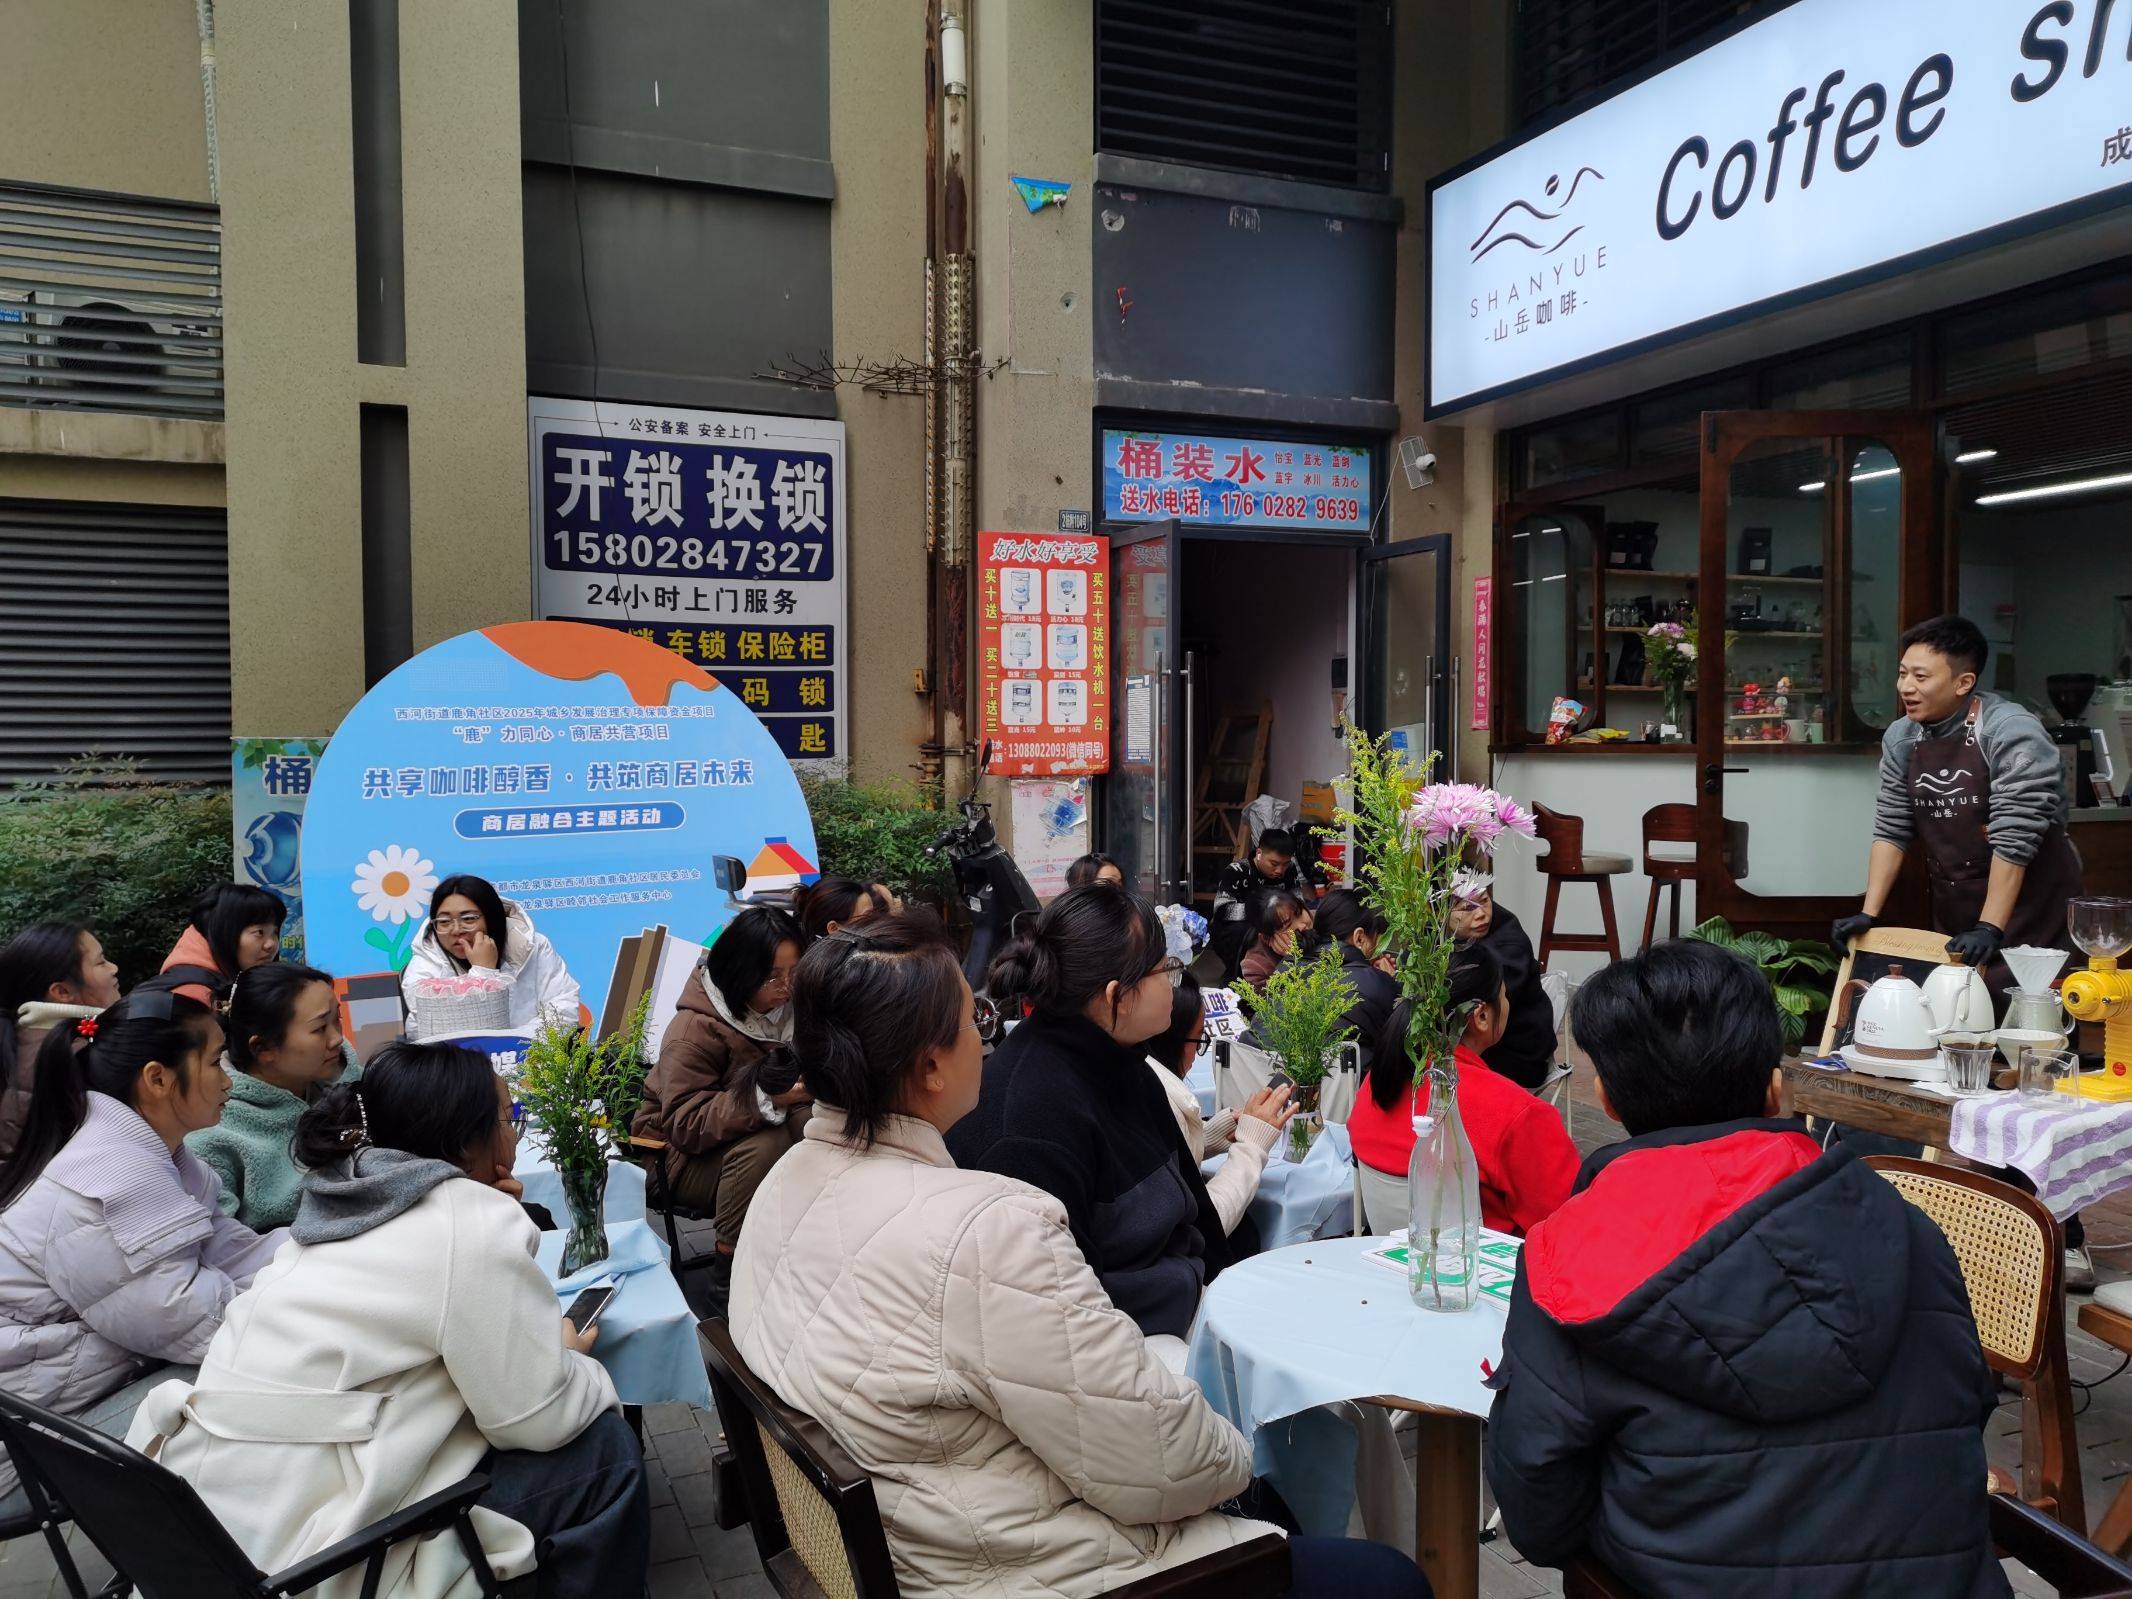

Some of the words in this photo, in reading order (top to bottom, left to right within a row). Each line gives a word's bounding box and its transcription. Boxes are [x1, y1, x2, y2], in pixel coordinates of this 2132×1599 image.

[1655, 52, 1955, 241] Coffee
[2100, 125, 2132, 168] 成
[1470, 246, 1606, 318] SHANYUE
[628, 417, 690, 437] 公安备案
[698, 422, 757, 441] 安全上门
[1118, 438, 1266, 485] 桶装水
[553, 446, 685, 528] 开锁
[705, 454, 828, 535] 换锁
[1303, 473, 1321, 486] 冰川
[1332, 474, 1360, 489] 活力心
[1221, 492, 1254, 517] 176
[1263, 494, 1307, 519] 0282
[1316, 497, 1360, 522] 9639
[553, 530, 825, 574] 15802847327
[989, 537, 1099, 565] 好水好享受
[587, 583, 799, 615] 24小时上门服务
[984, 568, 998, 632] 买十送一
[666, 629, 727, 661] 车锁
[737, 629, 828, 661] 保险柜
[1091, 572, 1105, 732] 买五十送饮水机一台
[985, 647, 999, 733] 买二十送三
[481, 807, 662, 832] 商居融合主题活动
[1915, 795, 1979, 807] SHANYUE
[492, 868, 700, 892] 都市龙泉驿区西河街道鹿角社区居民委员会
